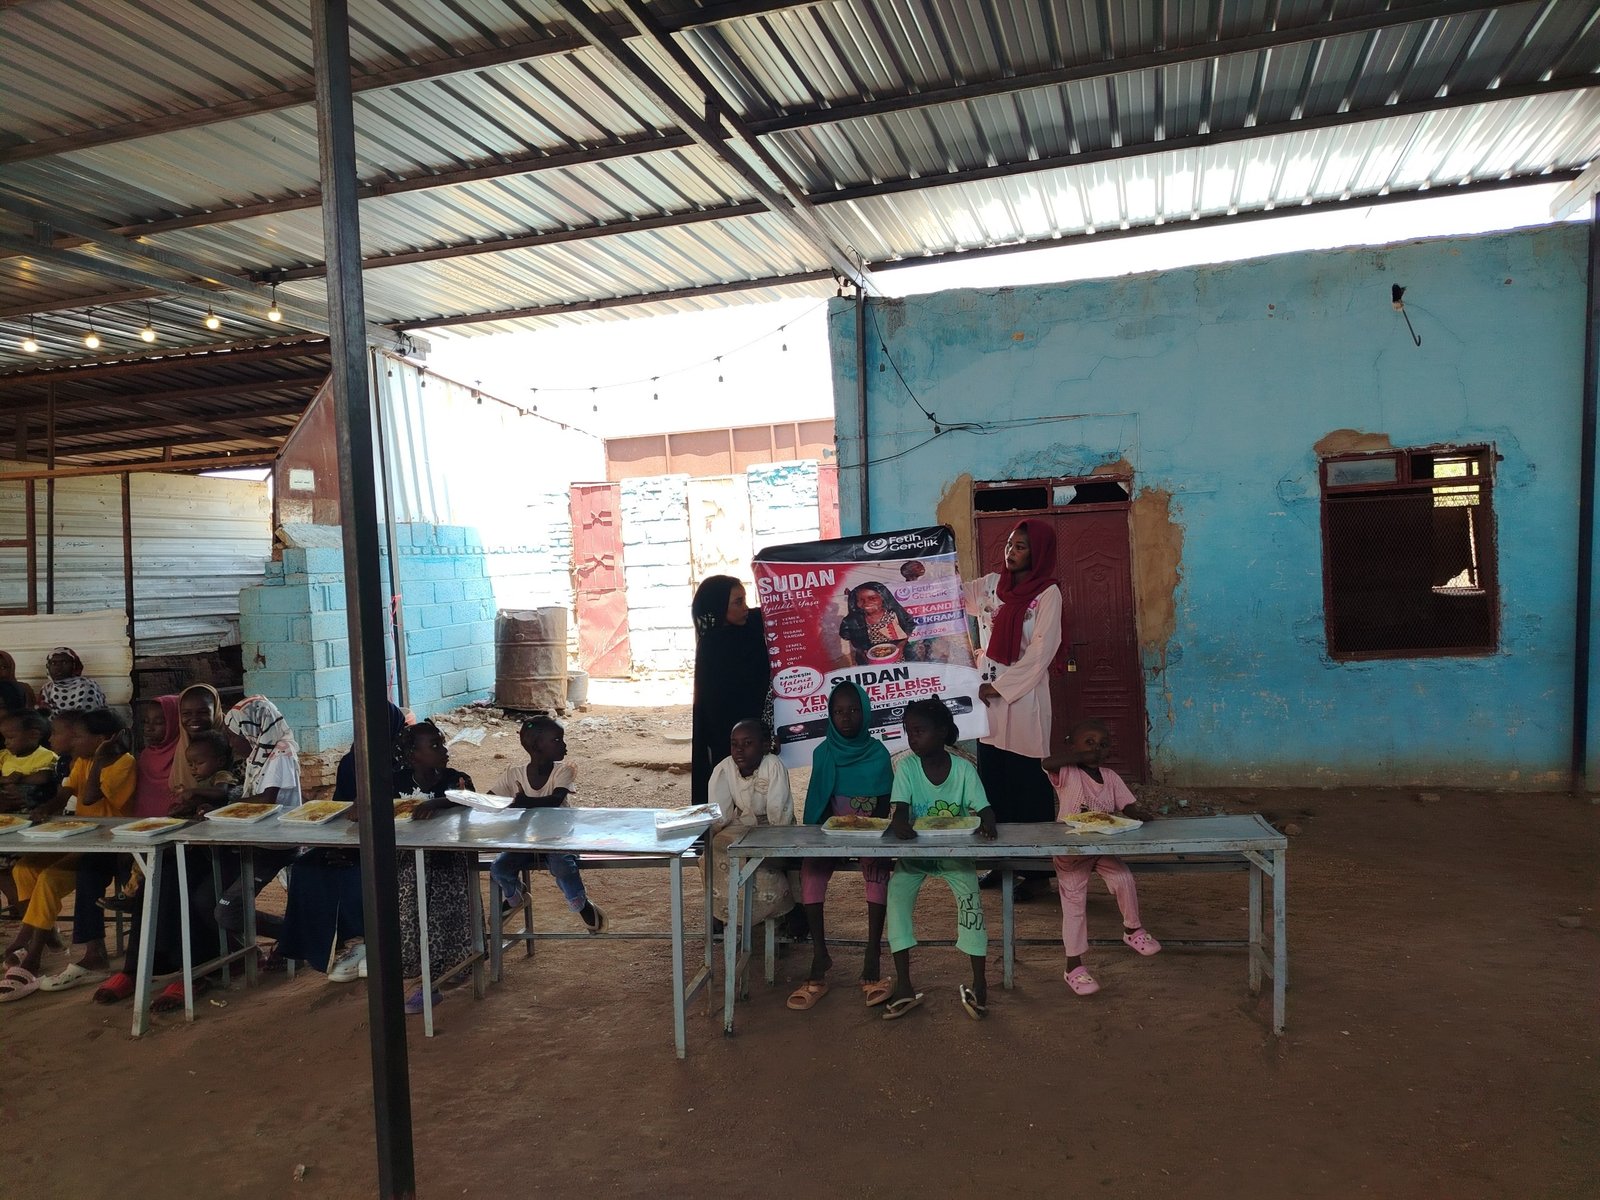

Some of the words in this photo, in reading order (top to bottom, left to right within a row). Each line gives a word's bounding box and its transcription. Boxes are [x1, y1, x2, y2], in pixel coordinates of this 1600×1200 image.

[889, 533, 921, 545] Fetih
[889, 539, 939, 551] Gençlik
[758, 569, 835, 594] SUDAN
[761, 594, 779, 604] İÇİN
[782, 592, 793, 601] EL
[796, 590, 813, 599] ELE
[885, 676, 942, 693] ELBİSE
[796, 704, 827, 715] YARD
[869, 685, 946, 703] ANİZASYONU
